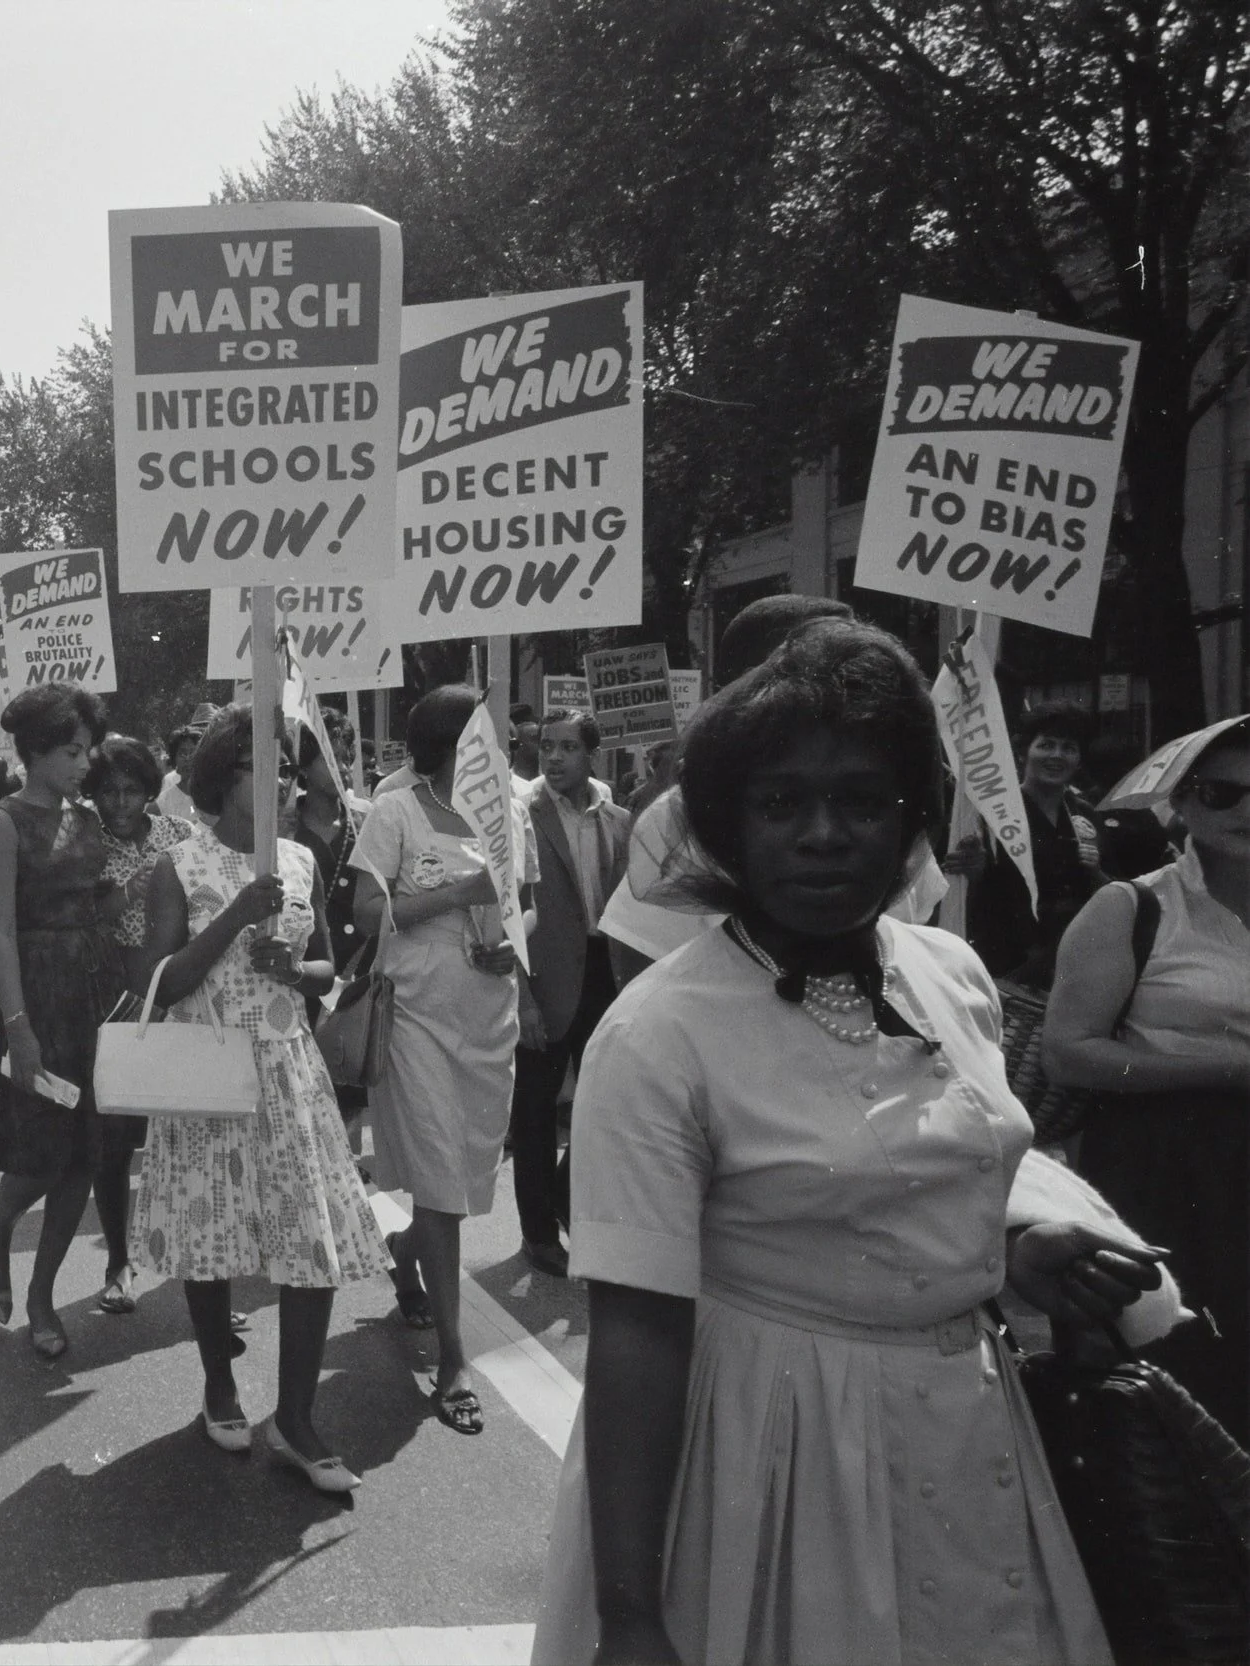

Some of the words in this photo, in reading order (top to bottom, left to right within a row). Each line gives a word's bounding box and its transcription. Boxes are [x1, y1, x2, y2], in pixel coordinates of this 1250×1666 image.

[221, 240, 293, 278] WE
[152, 282, 361, 335] MARCH
[219, 339, 299, 362] FOR
[460, 317, 550, 383] WE
[971, 340, 1059, 380] WE
[136, 381, 378, 431] INTEGRATED
[399, 347, 622, 457] DEMAND
[905, 382, 1113, 425] DEMAND
[137, 442, 376, 491] SCHOOLS
[422, 451, 609, 505] DECENT
[904, 443, 979, 485] AN
[996, 457, 1097, 509] END
[156, 494, 366, 565] NOW!
[403, 507, 627, 561] HOUSING
[905, 485, 966, 525] TO
[980, 499, 1087, 553] BIAS
[34, 558, 69, 585] WE
[418, 545, 617, 616] NOW!
[896, 531, 1081, 602] NOW!
[11, 572, 97, 615] DEMAND
[239, 586, 364, 613] RGHTS
[20, 616, 49, 631] AN
[56, 614, 93, 628] END
[37, 633, 83, 648] POLICE
[25, 647, 92, 663] BRUTALITY
[26, 655, 105, 686] NOW!
[551, 690, 590, 699] MARCH
[593, 666, 643, 689] JOBS
[594, 685, 668, 711] FREEDOM
[453, 734, 509, 871] FREEDOM
[992, 803, 1009, 822] IN
[999, 819, 1027, 858] '63
